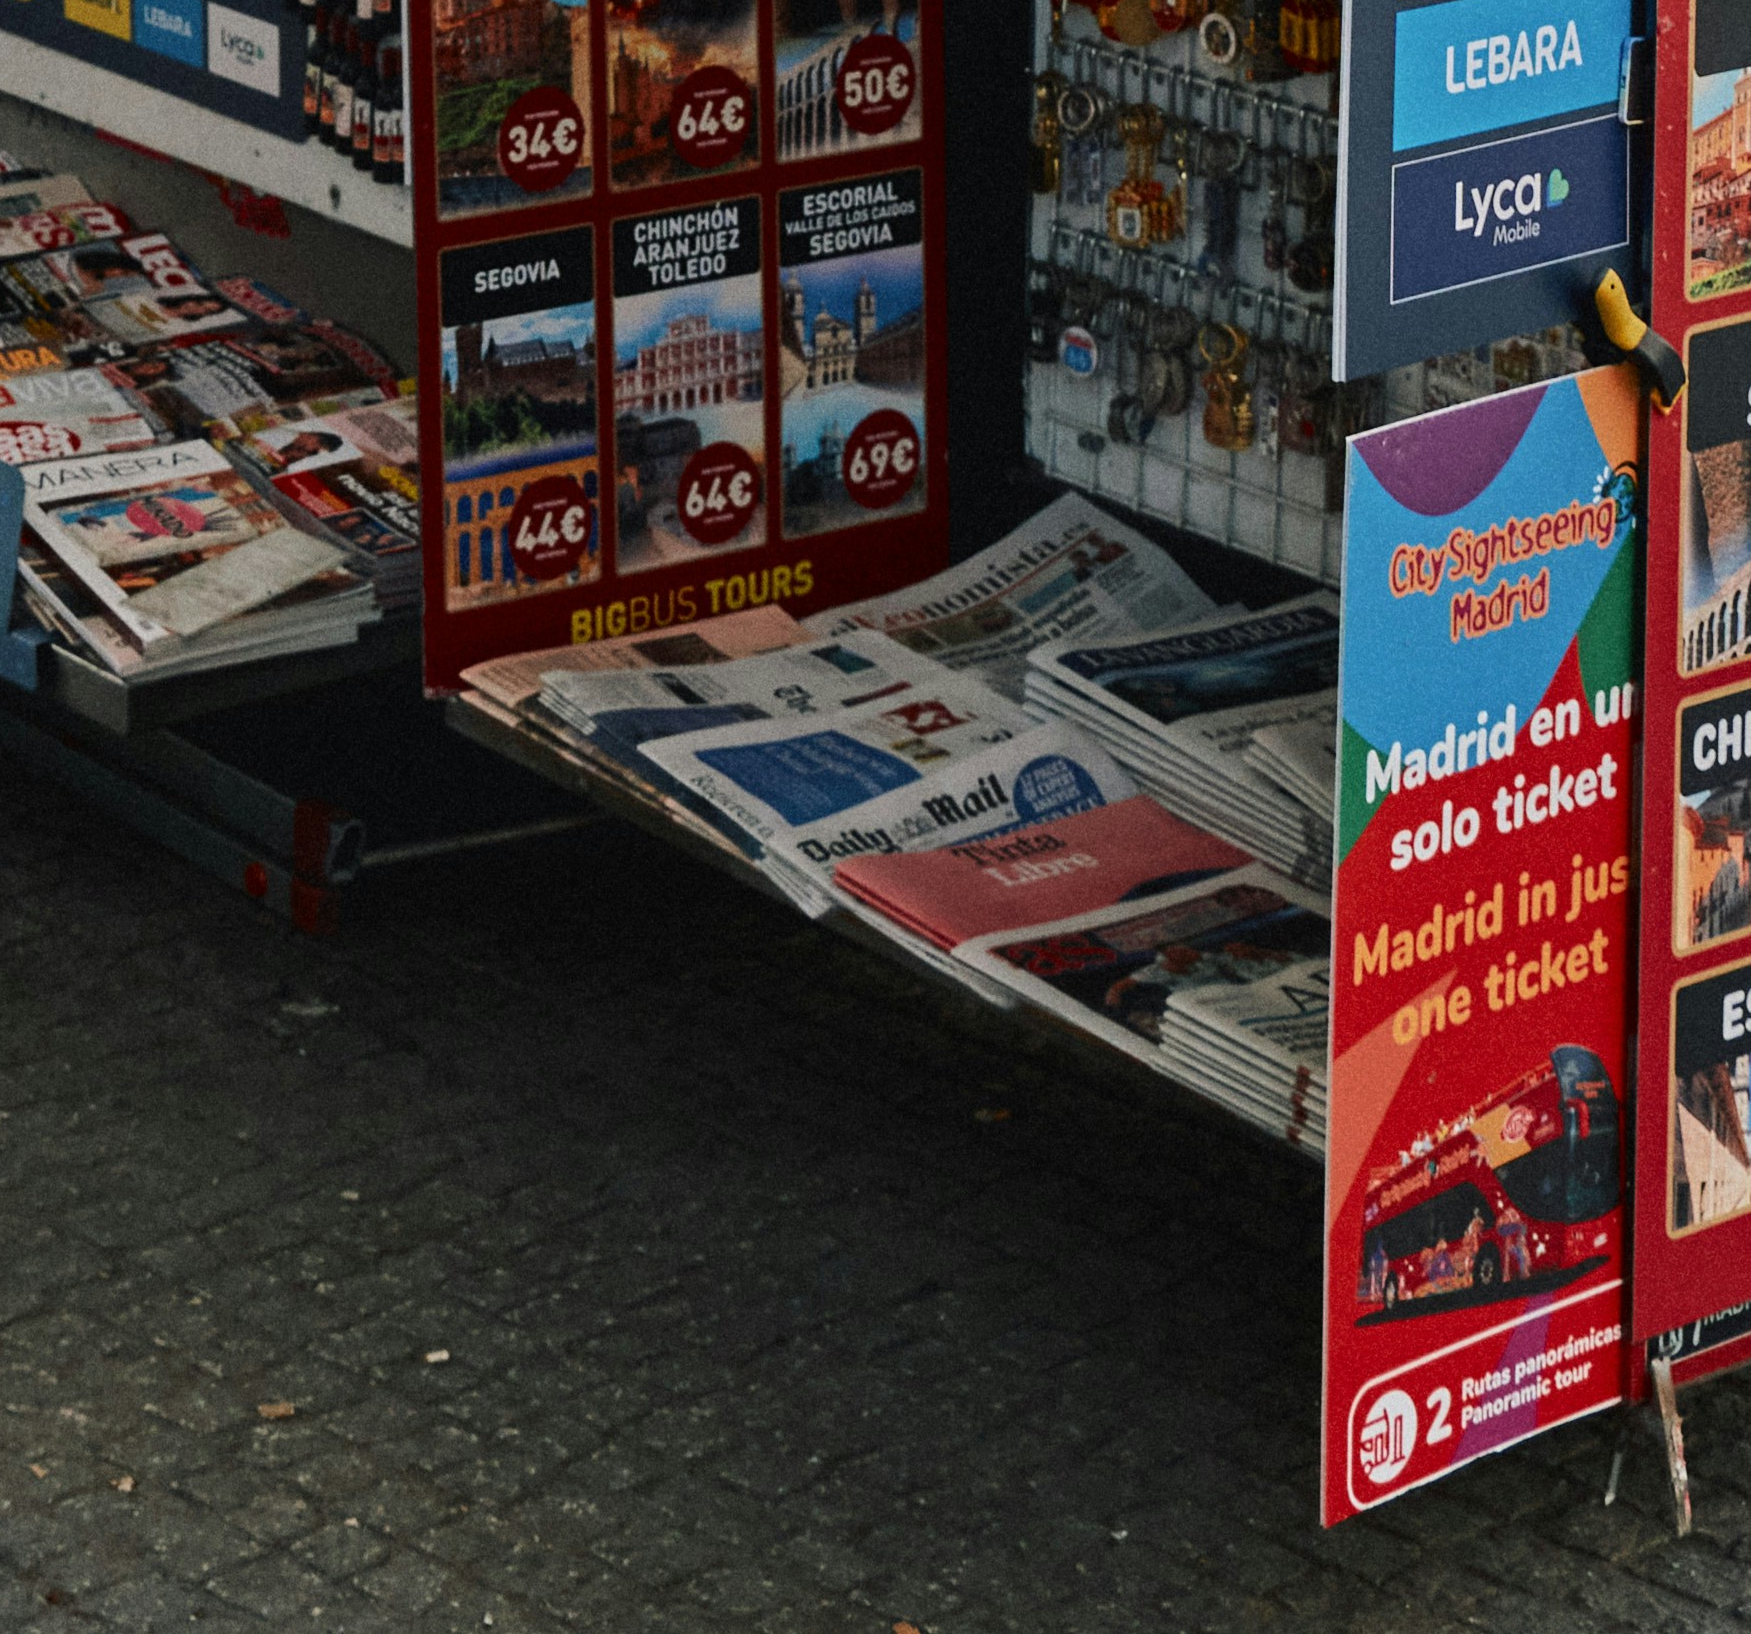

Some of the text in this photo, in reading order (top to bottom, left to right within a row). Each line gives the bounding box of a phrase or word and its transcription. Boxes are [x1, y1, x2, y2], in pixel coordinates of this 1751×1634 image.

[220, 29, 256, 63] Lyca
[1446, 19, 1583, 95] LEBARA
[843, 63, 910, 111] 50€
[507, 116, 578, 165] 34€
[677, 95, 746, 142] 64€
[785, 206, 868, 236] VALLE DE LOS
[802, 180, 898, 216] ESCORIAL
[1455, 166, 1543, 239] Lyca
[633, 227, 740, 268] ARANJUEZ
[634, 202, 739, 245] CHINCHÓN
[809, 221, 893, 257] SEGOVIA
[1492, 217, 1541, 247] Mobile
[474, 258, 561, 295] SEGOVIA
[648, 253, 727, 287] TOLEDO
[16, 374, 104, 404] viva
[24, 447, 201, 492] MANERA
[849, 436, 916, 485] 69€
[684, 470, 753, 519] 64€
[515, 504, 586, 555] 44€
[1390, 496, 1619, 598] City Sightseeing
[705, 560, 814, 614] TOURS
[1451, 567, 1551, 643] Madrid
[1366, 697, 1580, 804] Madrid en
[797, 824, 895, 865] Daily
[924, 772, 1011, 829] Mail
[1390, 752, 1618, 872] solo ticket
[953, 829, 1065, 869] Tinta
[985, 849, 1099, 889] Libre
[1353, 881, 1504, 987] Madrid
[1518, 869, 1557, 931] in
[1391, 928, 1610, 1047] one ticket
[1425, 1321, 1624, 1448] 2 Rutas panorámicas
[1461, 1361, 1594, 1431] Panoramic tour
